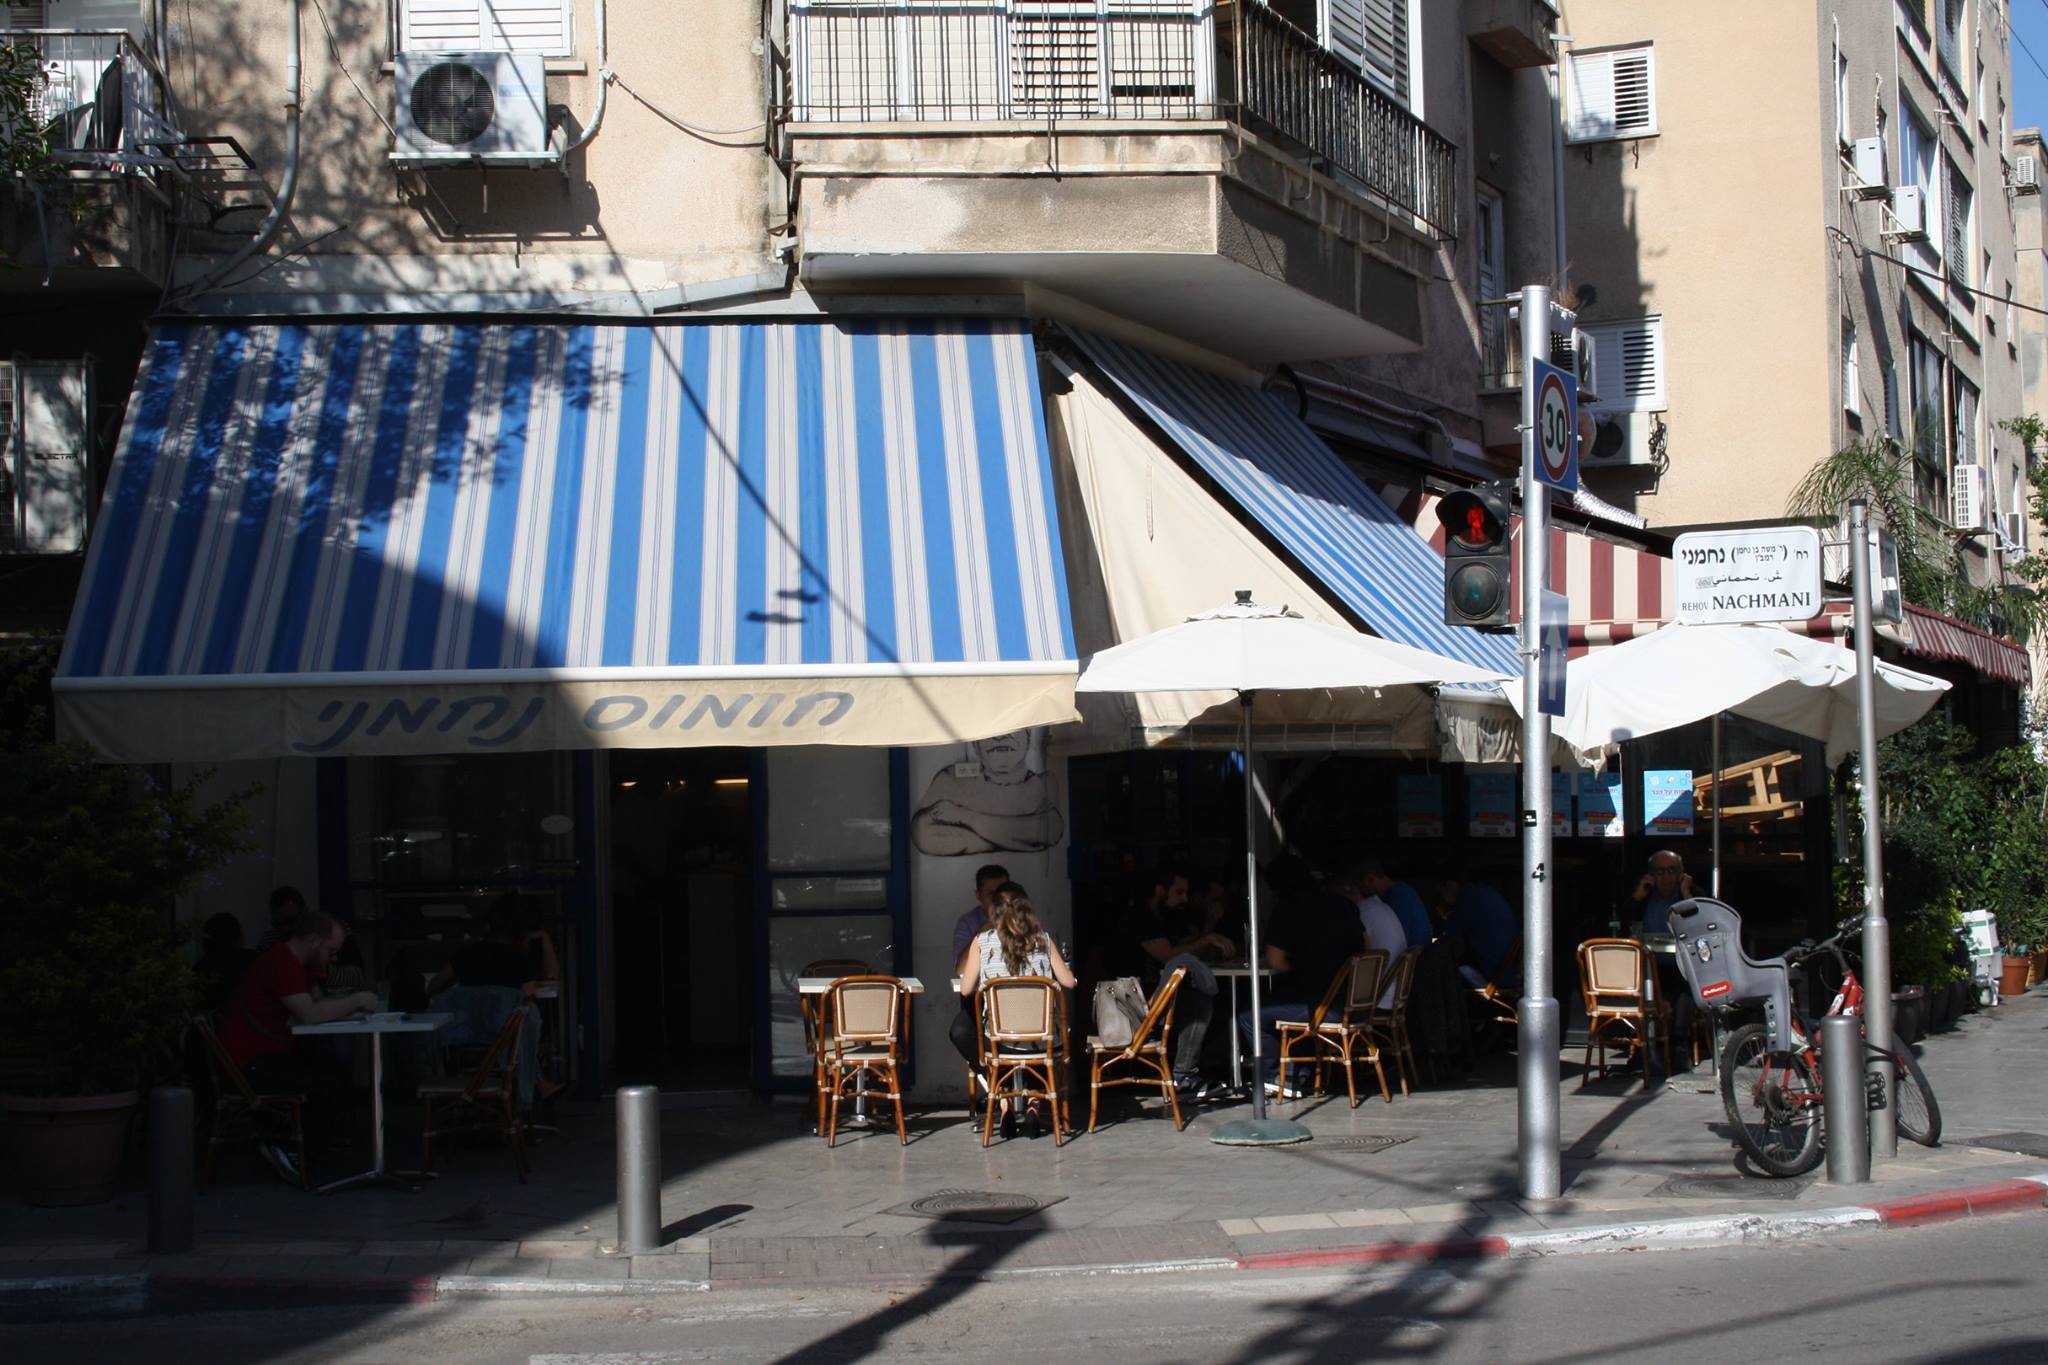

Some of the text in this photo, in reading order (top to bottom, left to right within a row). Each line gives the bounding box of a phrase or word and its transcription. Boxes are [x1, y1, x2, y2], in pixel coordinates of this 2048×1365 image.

[1545, 403, 1565, 453] 30
[1681, 547, 1725, 565] נחמני
[1682, 592, 1811, 611] REHOV NACHMANI
[292, 691, 855, 752] חומוס נחמני
